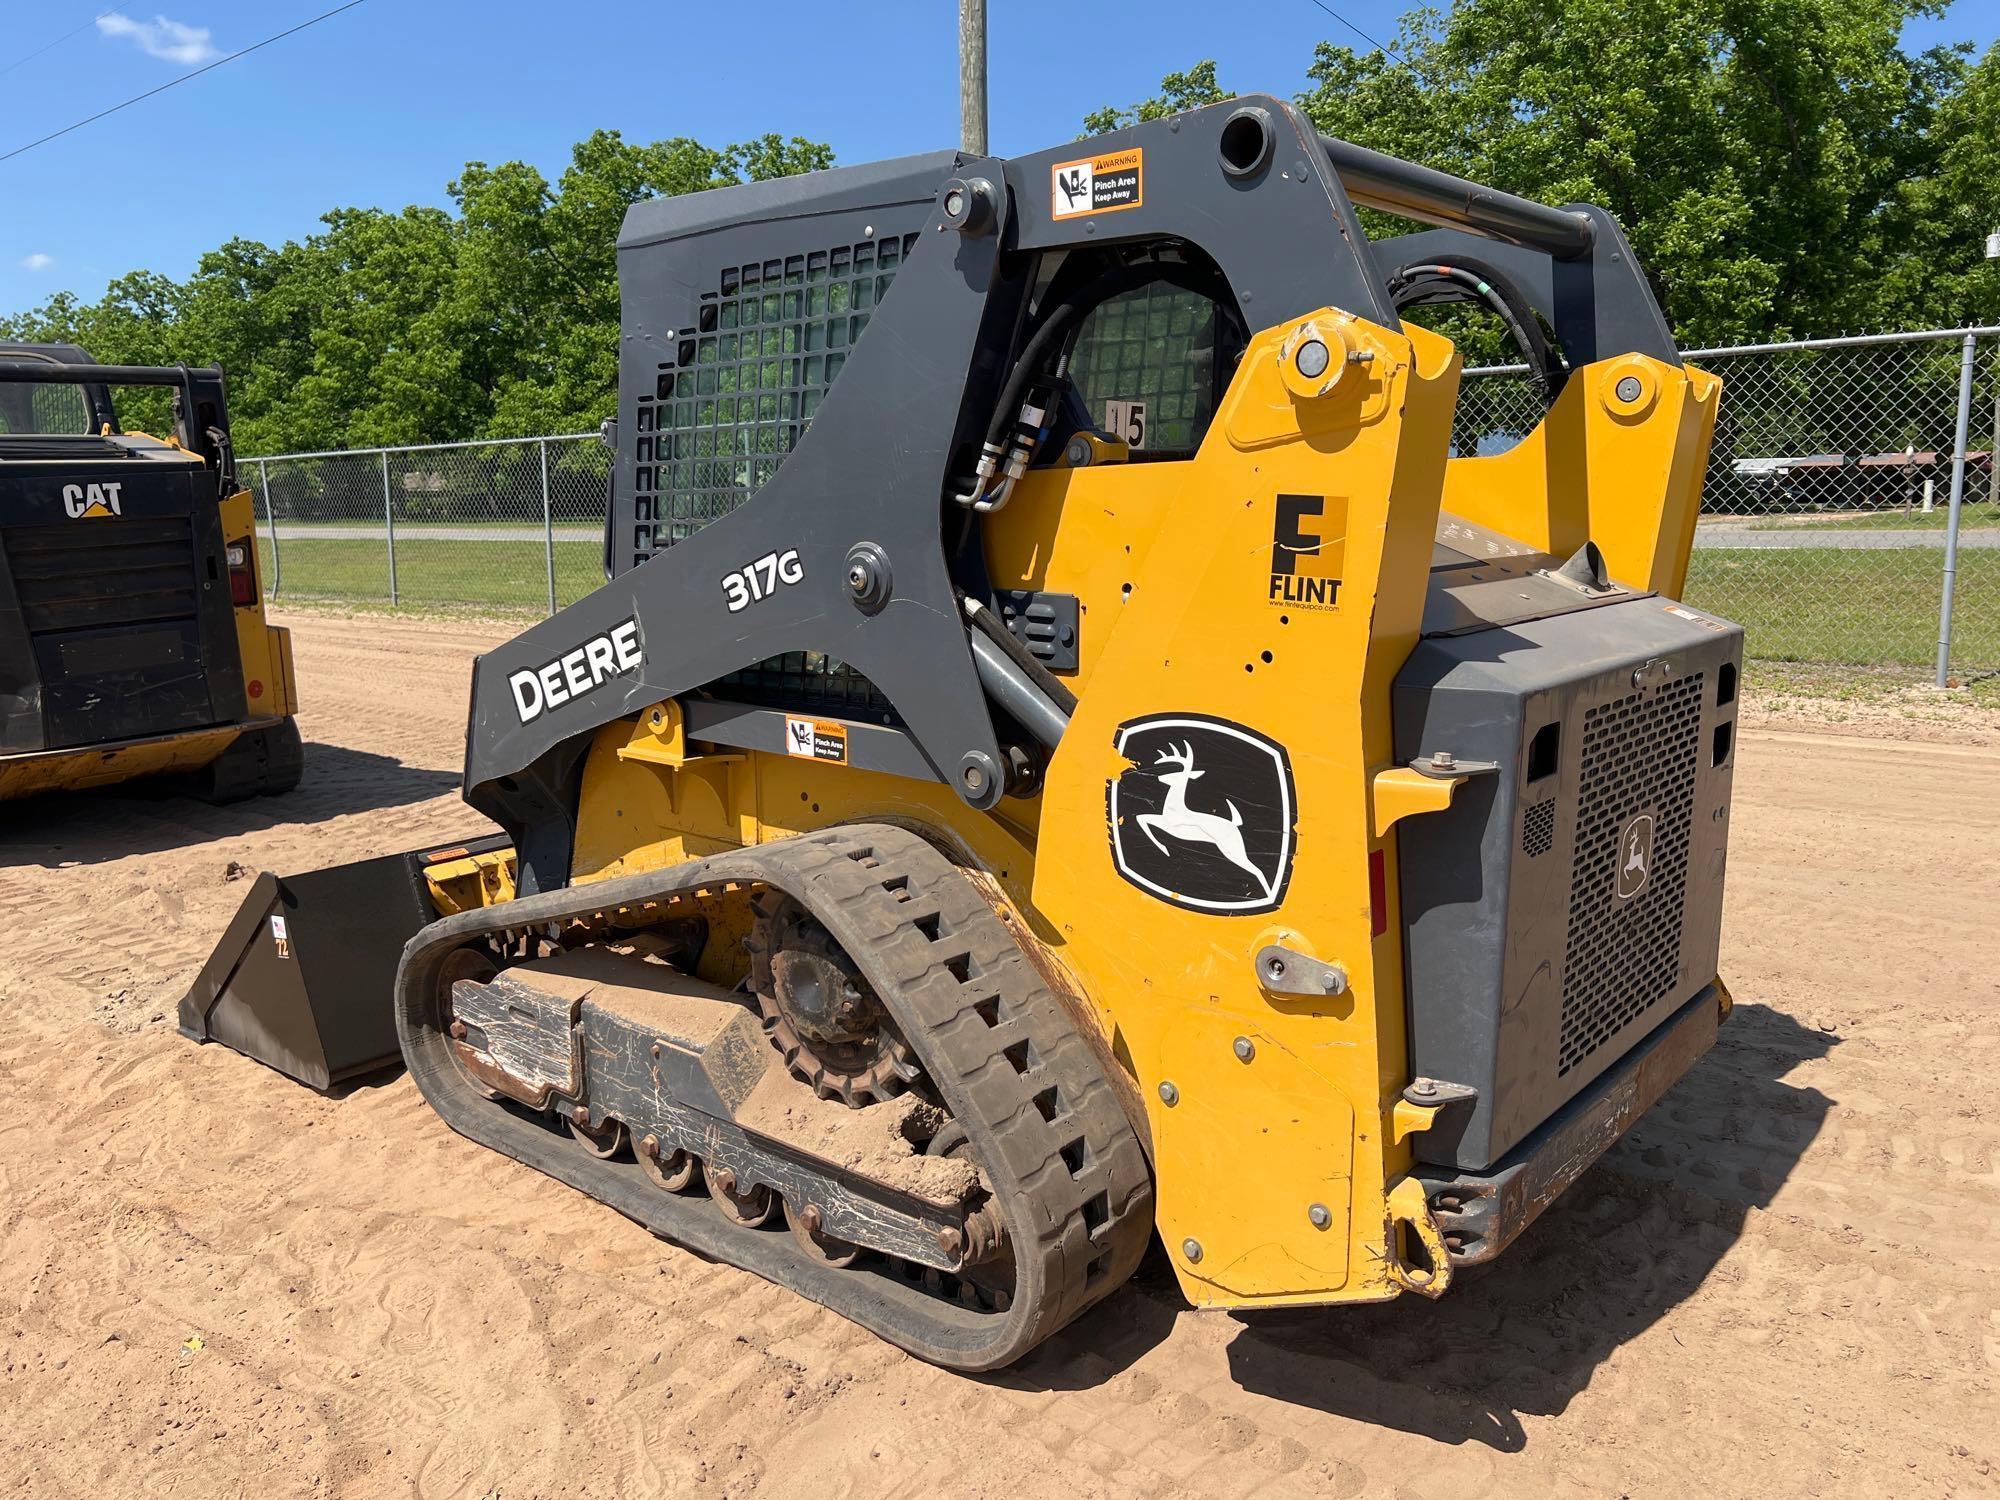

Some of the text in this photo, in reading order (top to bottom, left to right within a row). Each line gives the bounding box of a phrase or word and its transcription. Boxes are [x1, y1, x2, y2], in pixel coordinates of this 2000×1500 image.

[1102, 155, 1137, 168] WARNING
[1094, 177, 1136, 191] Pinch Area
[1094, 190, 1131, 202] Keep Away
[62, 482, 122, 519] CAT
[721, 549, 804, 612] 317G
[1269, 574, 1342, 605] FLINT
[508, 619, 643, 723] DEERE
[815, 737, 844, 750] Pinch Area
[815, 746, 840, 758] Keep Away
